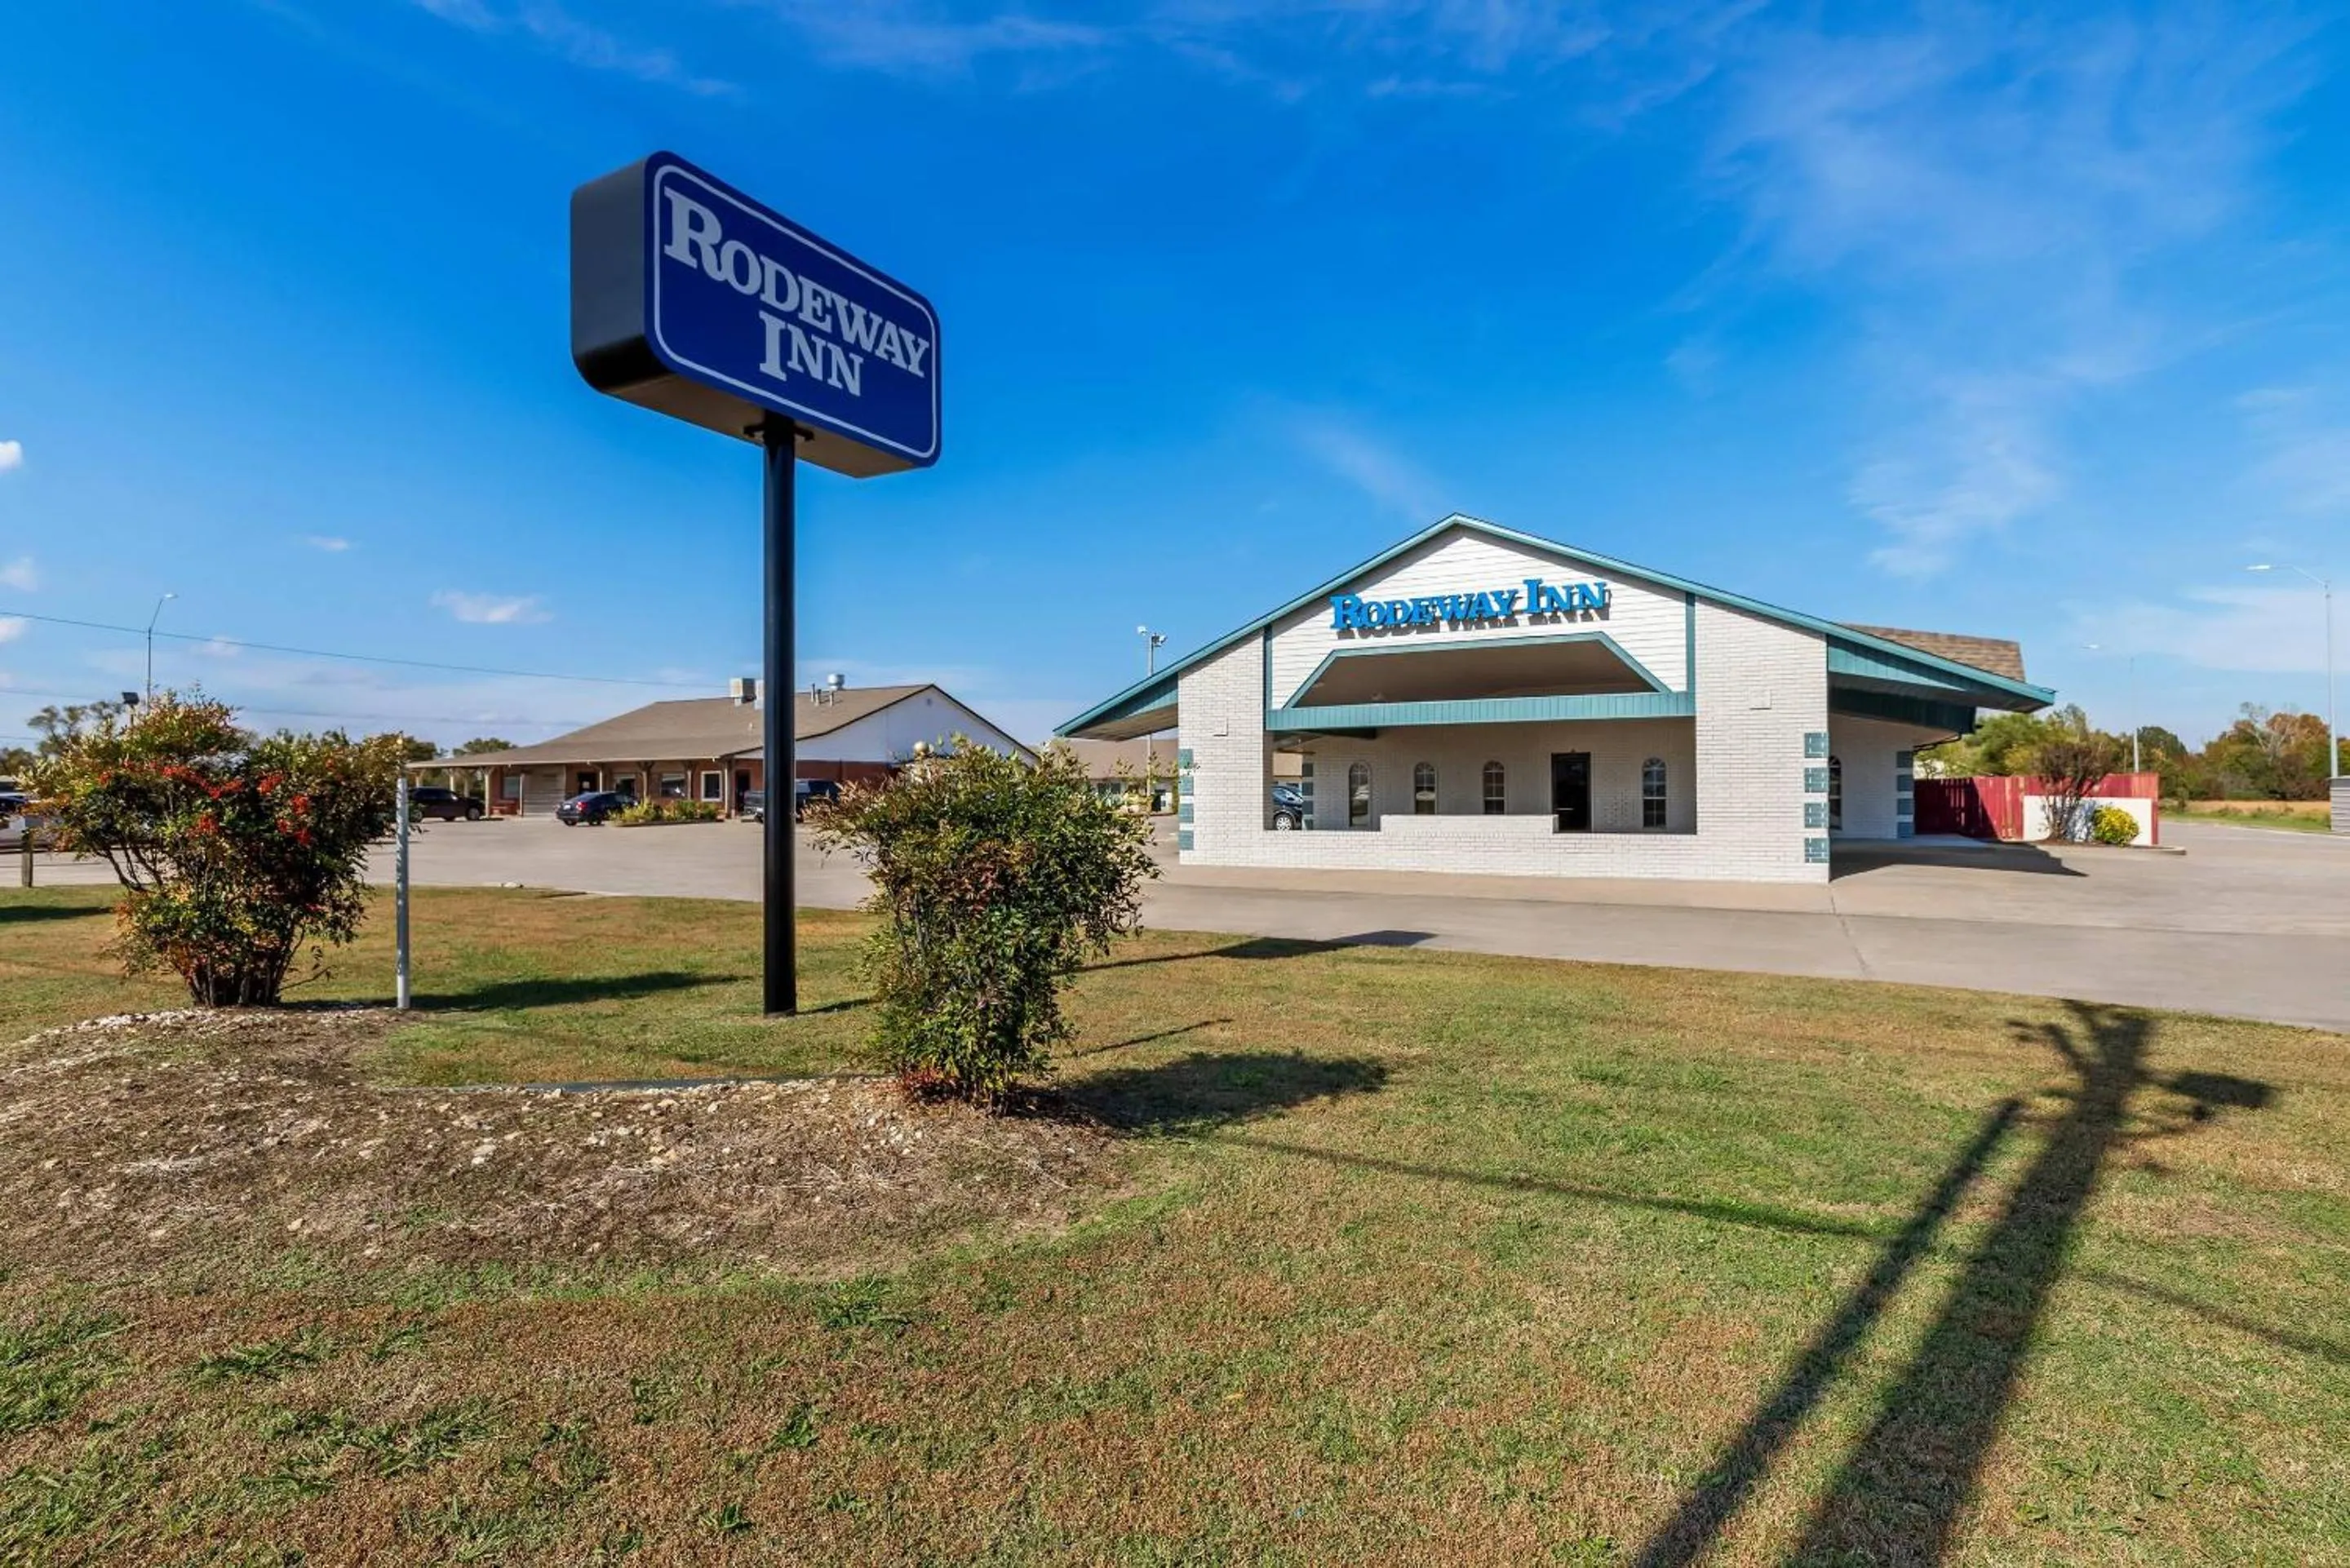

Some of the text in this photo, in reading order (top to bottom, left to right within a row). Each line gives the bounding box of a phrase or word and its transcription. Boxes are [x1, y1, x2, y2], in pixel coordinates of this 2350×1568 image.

[663, 187, 929, 378] RODEWAY
[759, 311, 864, 396] INN
[1329, 578, 1607, 630] RODEWAY INN
